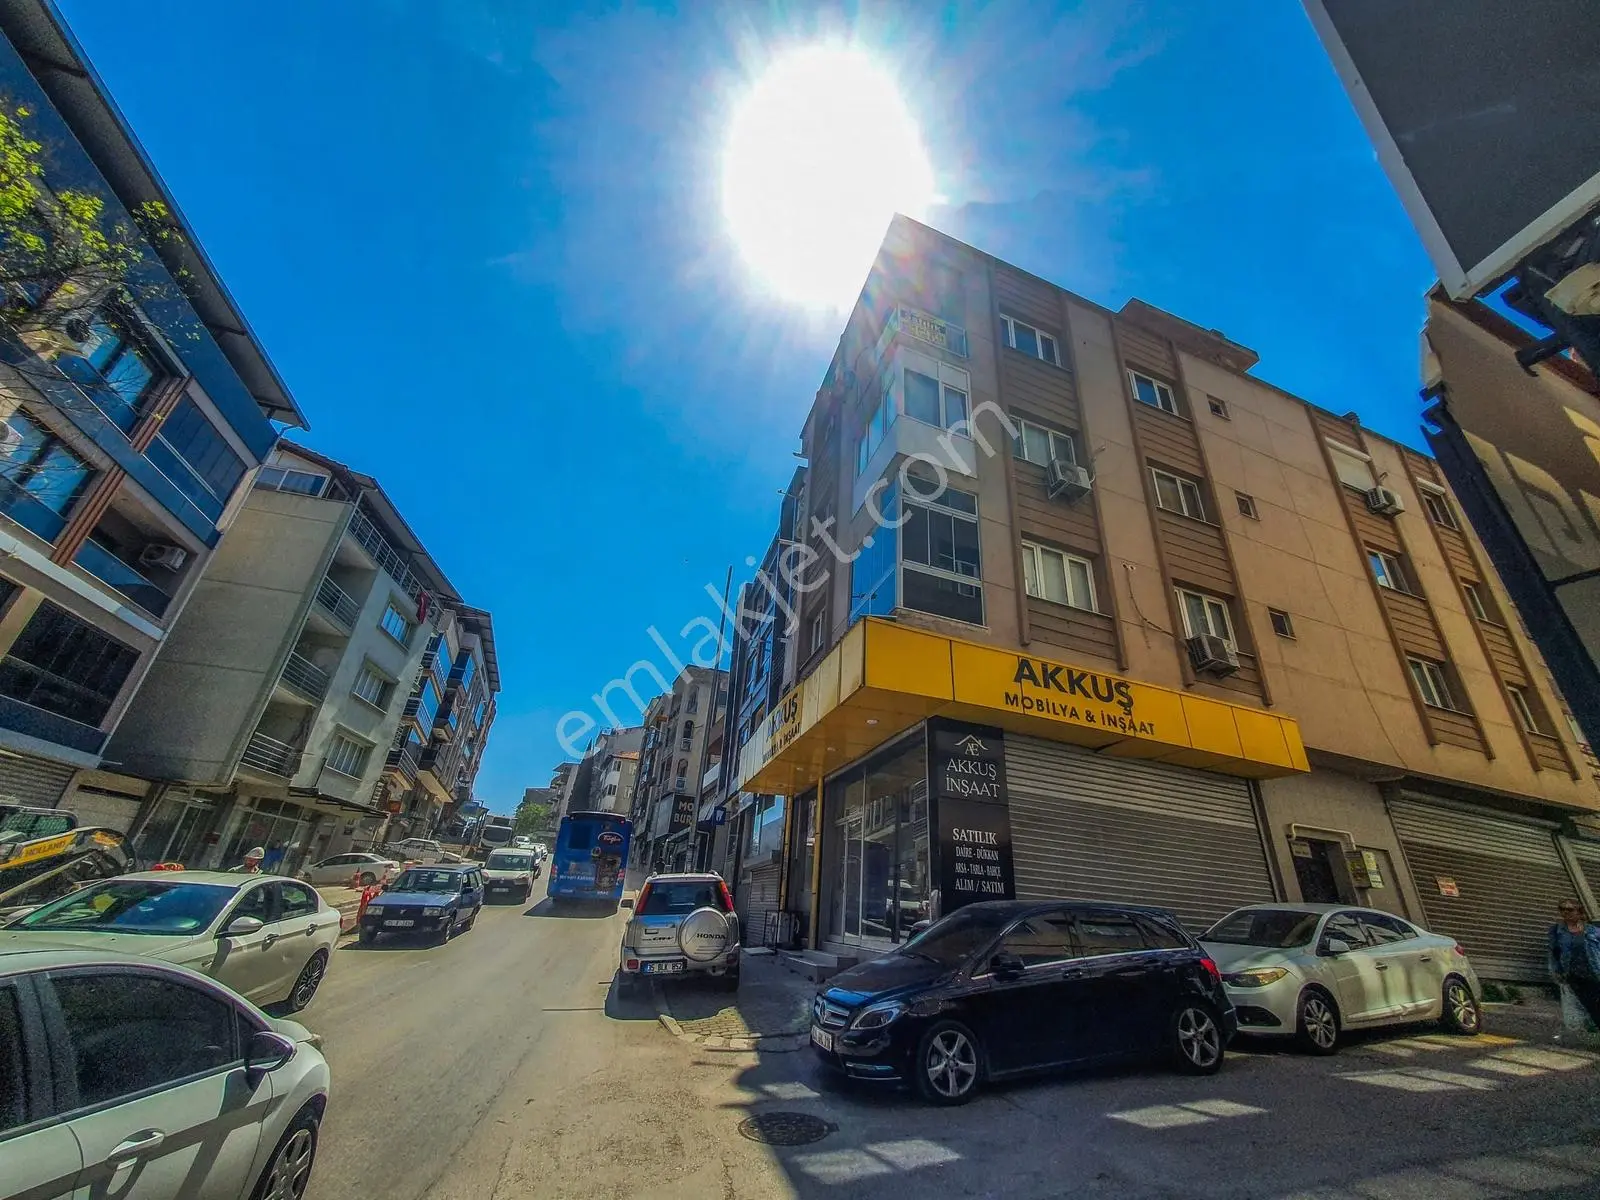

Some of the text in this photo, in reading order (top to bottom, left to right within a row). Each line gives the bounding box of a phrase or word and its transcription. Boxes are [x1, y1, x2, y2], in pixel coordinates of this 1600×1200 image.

[1014, 659, 1134, 716] AKKUŞ
[1004, 692, 1155, 736] MOBİLYA & İNŞAAT
[946, 758, 997, 781] AKKUŞ
[946, 774, 1000, 798] İNŞAAT
[952, 828, 997, 845] SATILIK
[955, 844, 973, 858] DAİRE
[976, 847, 999, 861] DÜKKAN
[955, 878, 974, 891] ALIM
[981, 881, 1005, 894] SATIM
[696, 932, 726, 940] HONDA
